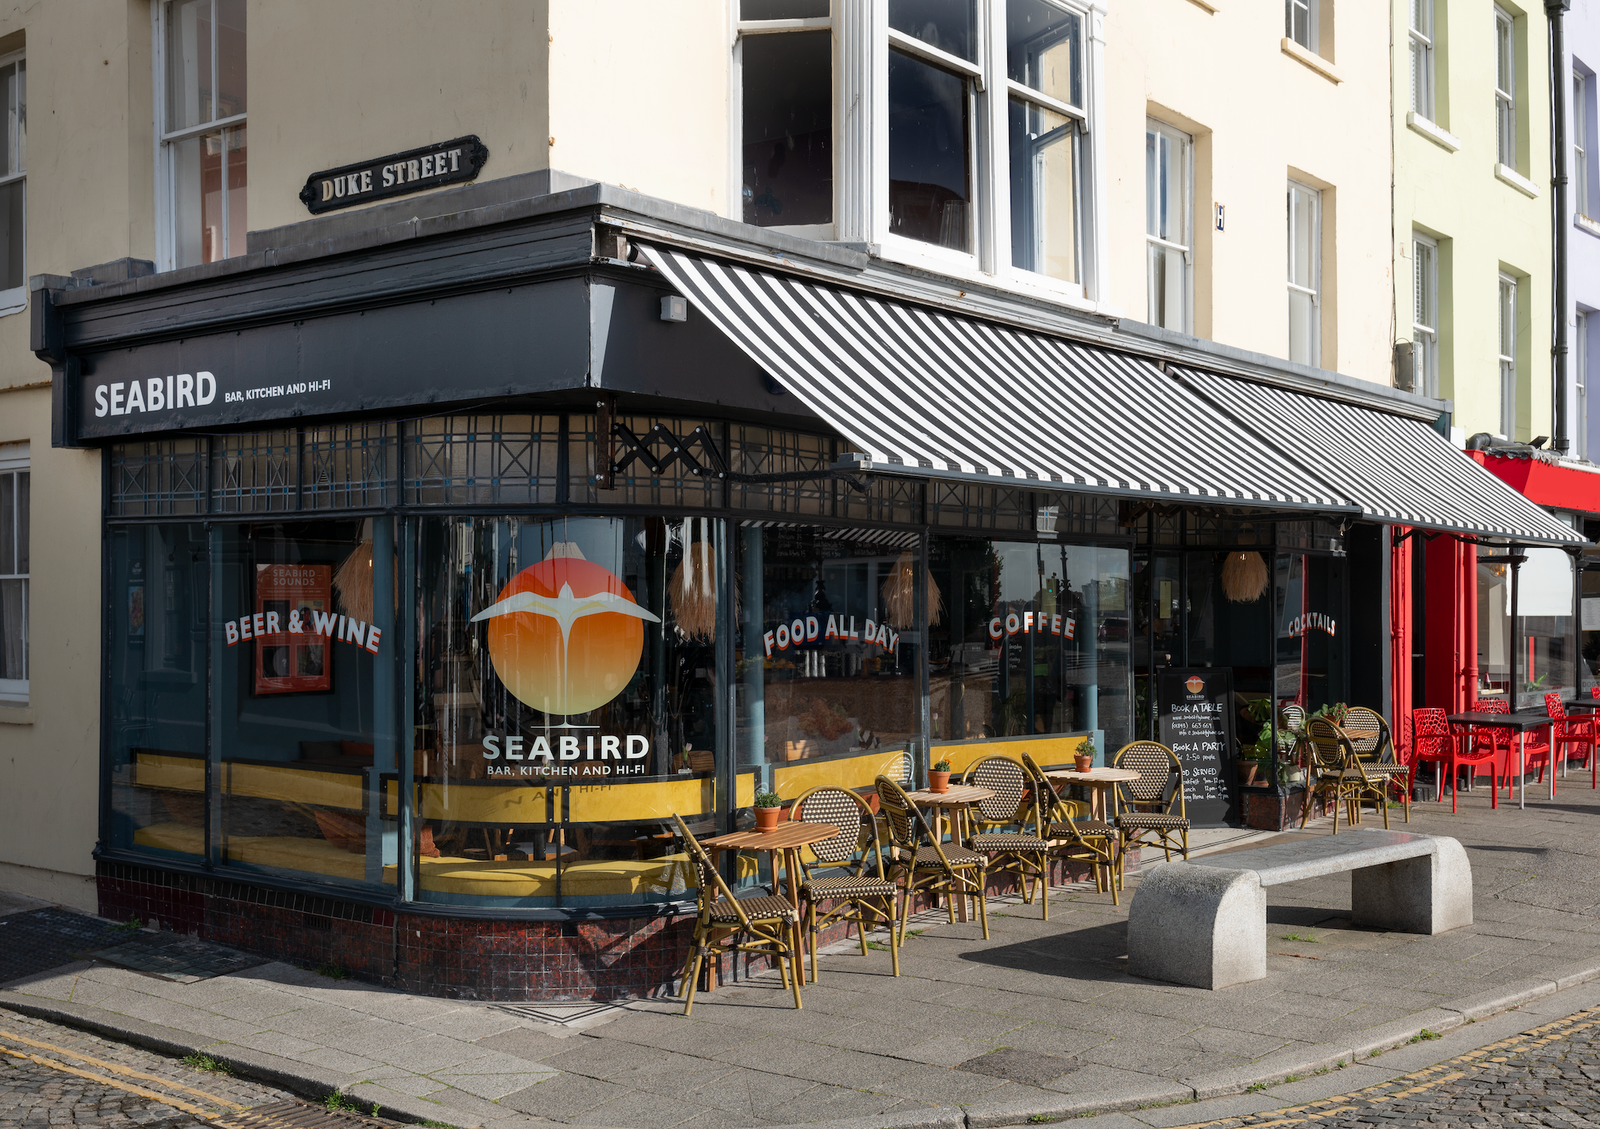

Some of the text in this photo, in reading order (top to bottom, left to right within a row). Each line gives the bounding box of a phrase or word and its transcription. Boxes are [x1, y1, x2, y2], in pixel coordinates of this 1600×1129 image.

[321, 148, 462, 202] DUKE STREET
[1217, 204, 1224, 229] H
[94, 370, 331, 418] SEABIRD BAR, KITCHEN AND HI-FI
[272, 569, 316, 578] SEABIRD
[273, 577, 315, 586] SOUNDS
[224, 609, 382, 656] BEER & WINE
[763, 614, 899, 660] FOOD ALL DAY
[988, 611, 1076, 640] COFFEE
[1288, 612, 1336, 639] COCKTAILS
[1192, 704, 1199, 713] A
[1199, 702, 1223, 713] TABLE
[482, 734, 650, 761] SEABIRD
[1192, 742, 1199, 751] A
[1201, 741, 1226, 751] PARTY
[487, 764, 645, 777] BAR, KITCHEN AND HI-FI
[1192, 767, 1217, 777] SERVED
